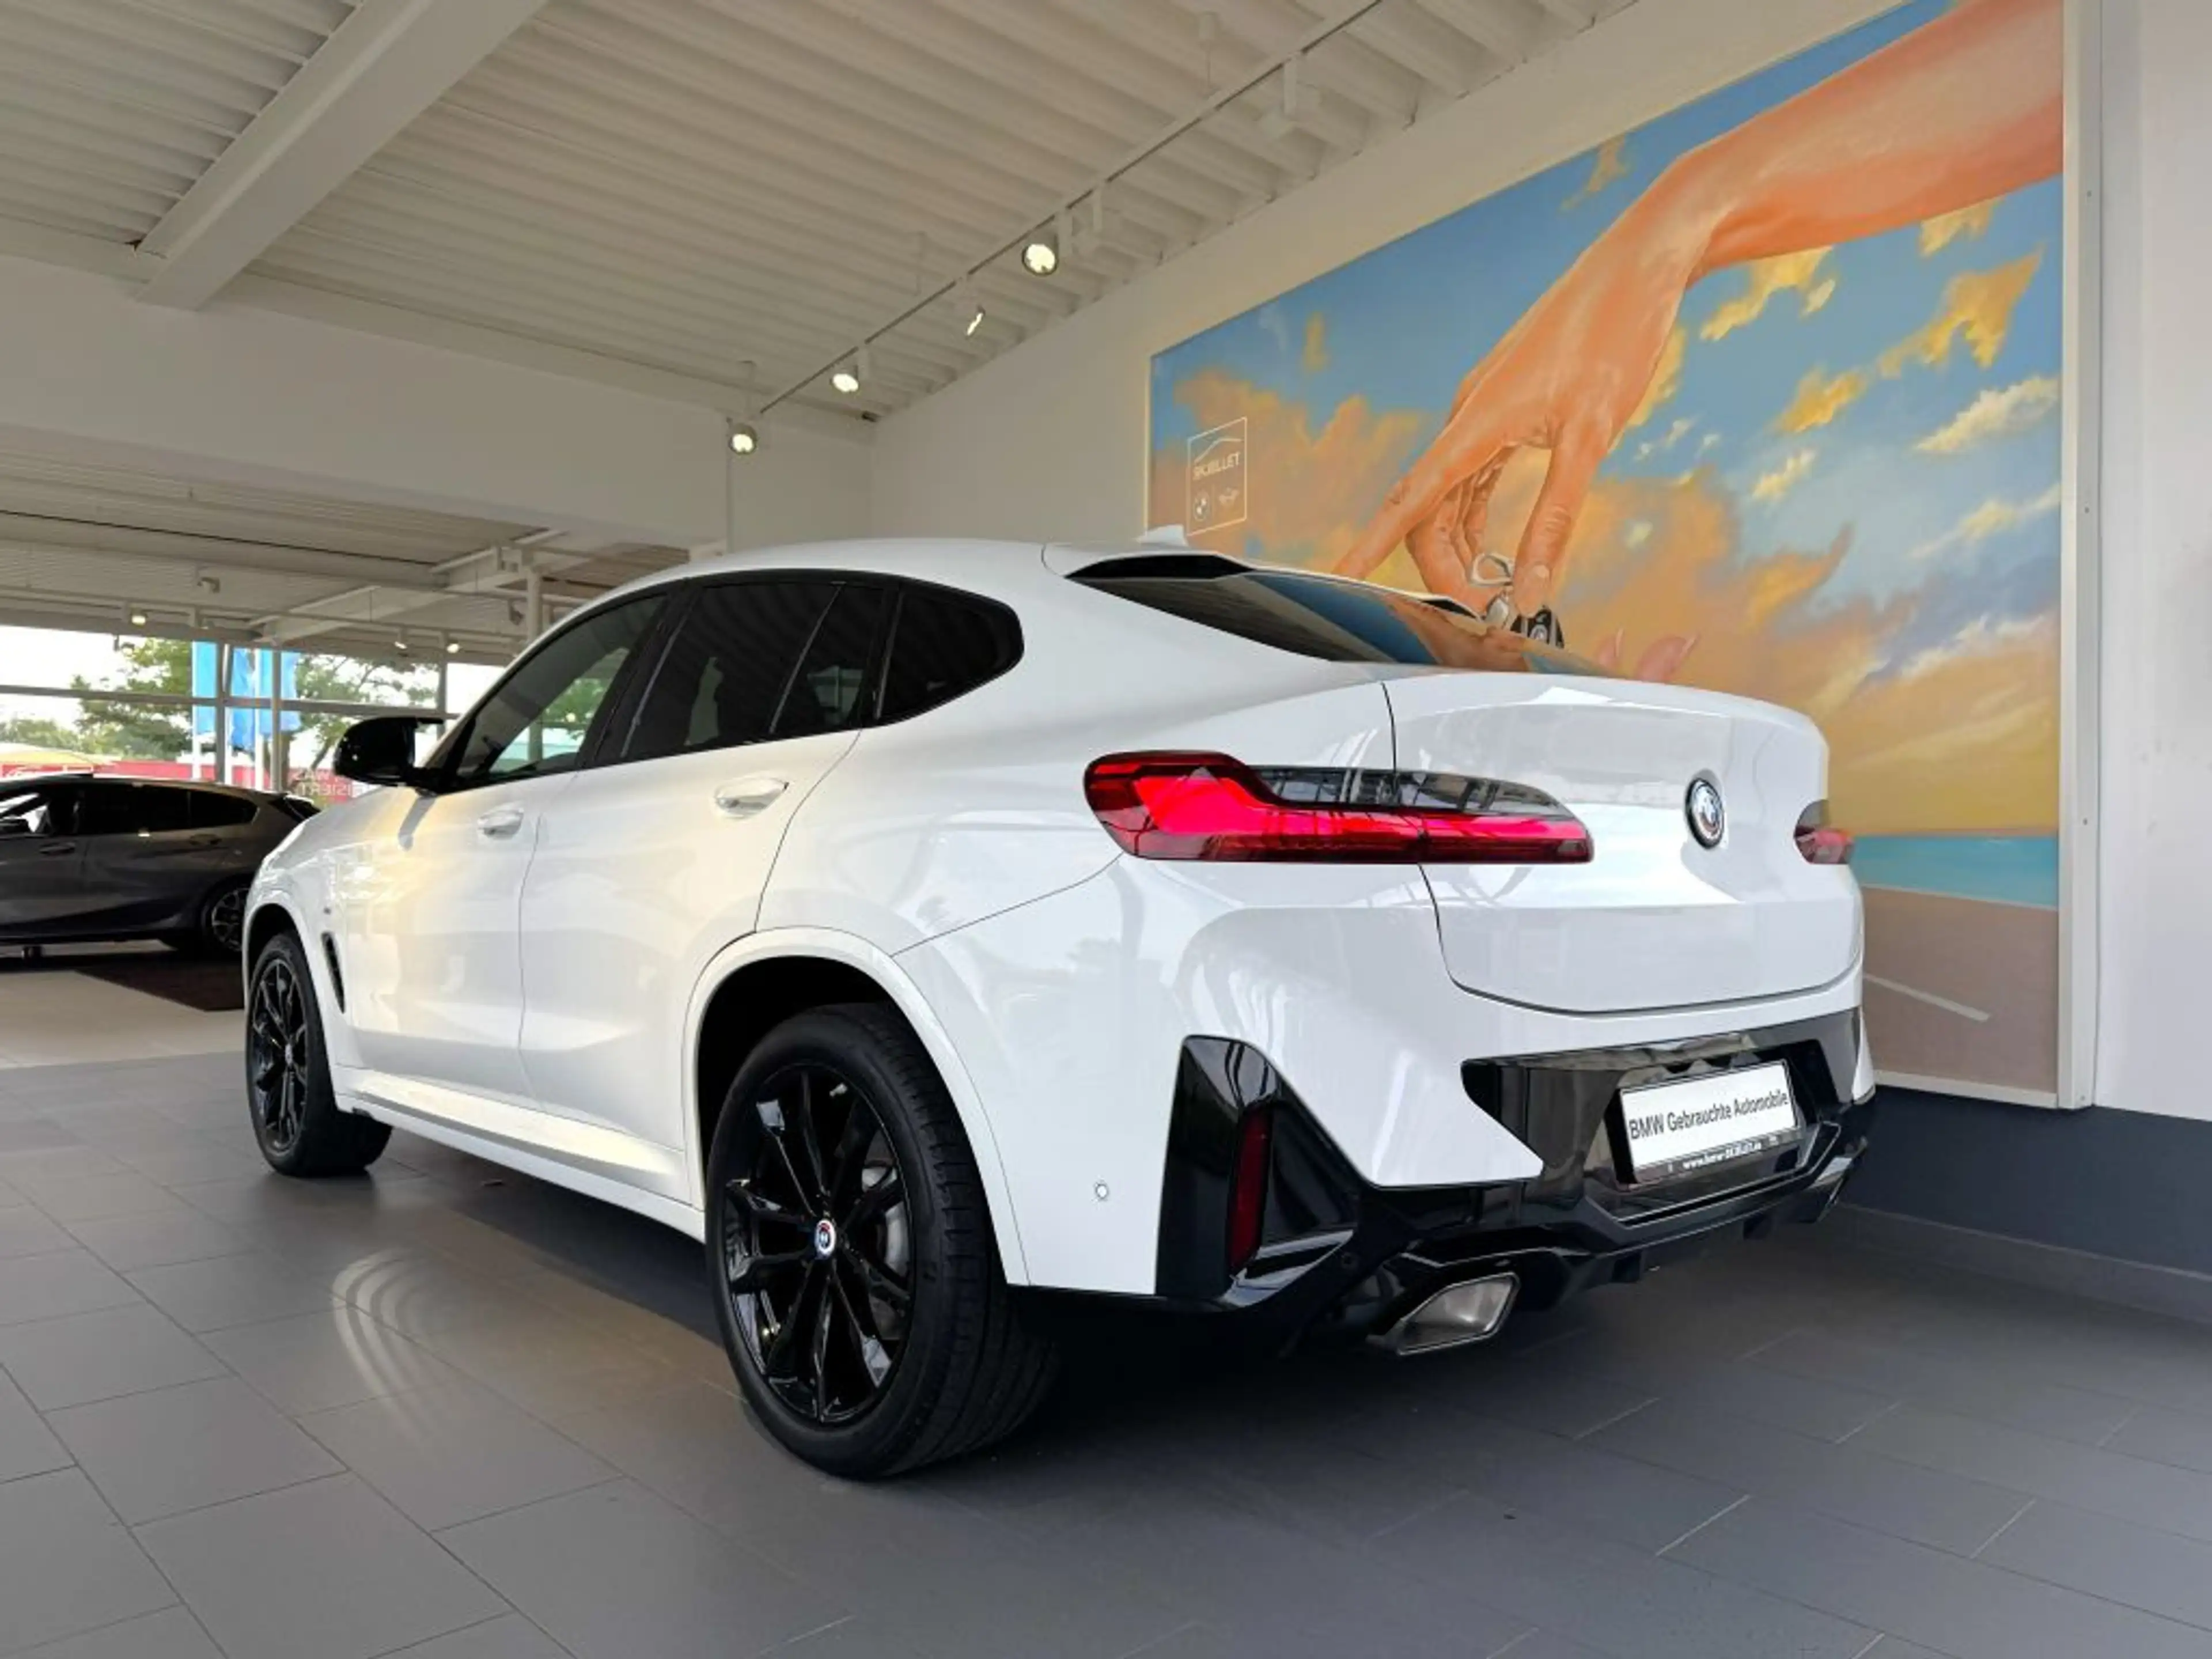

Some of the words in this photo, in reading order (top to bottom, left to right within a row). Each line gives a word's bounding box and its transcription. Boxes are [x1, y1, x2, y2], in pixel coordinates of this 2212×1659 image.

[1629, 1113, 1664, 1140] BMW
[1667, 1103, 1731, 1131] Gebrauchte
[1734, 1089, 1789, 1117] Automobile
